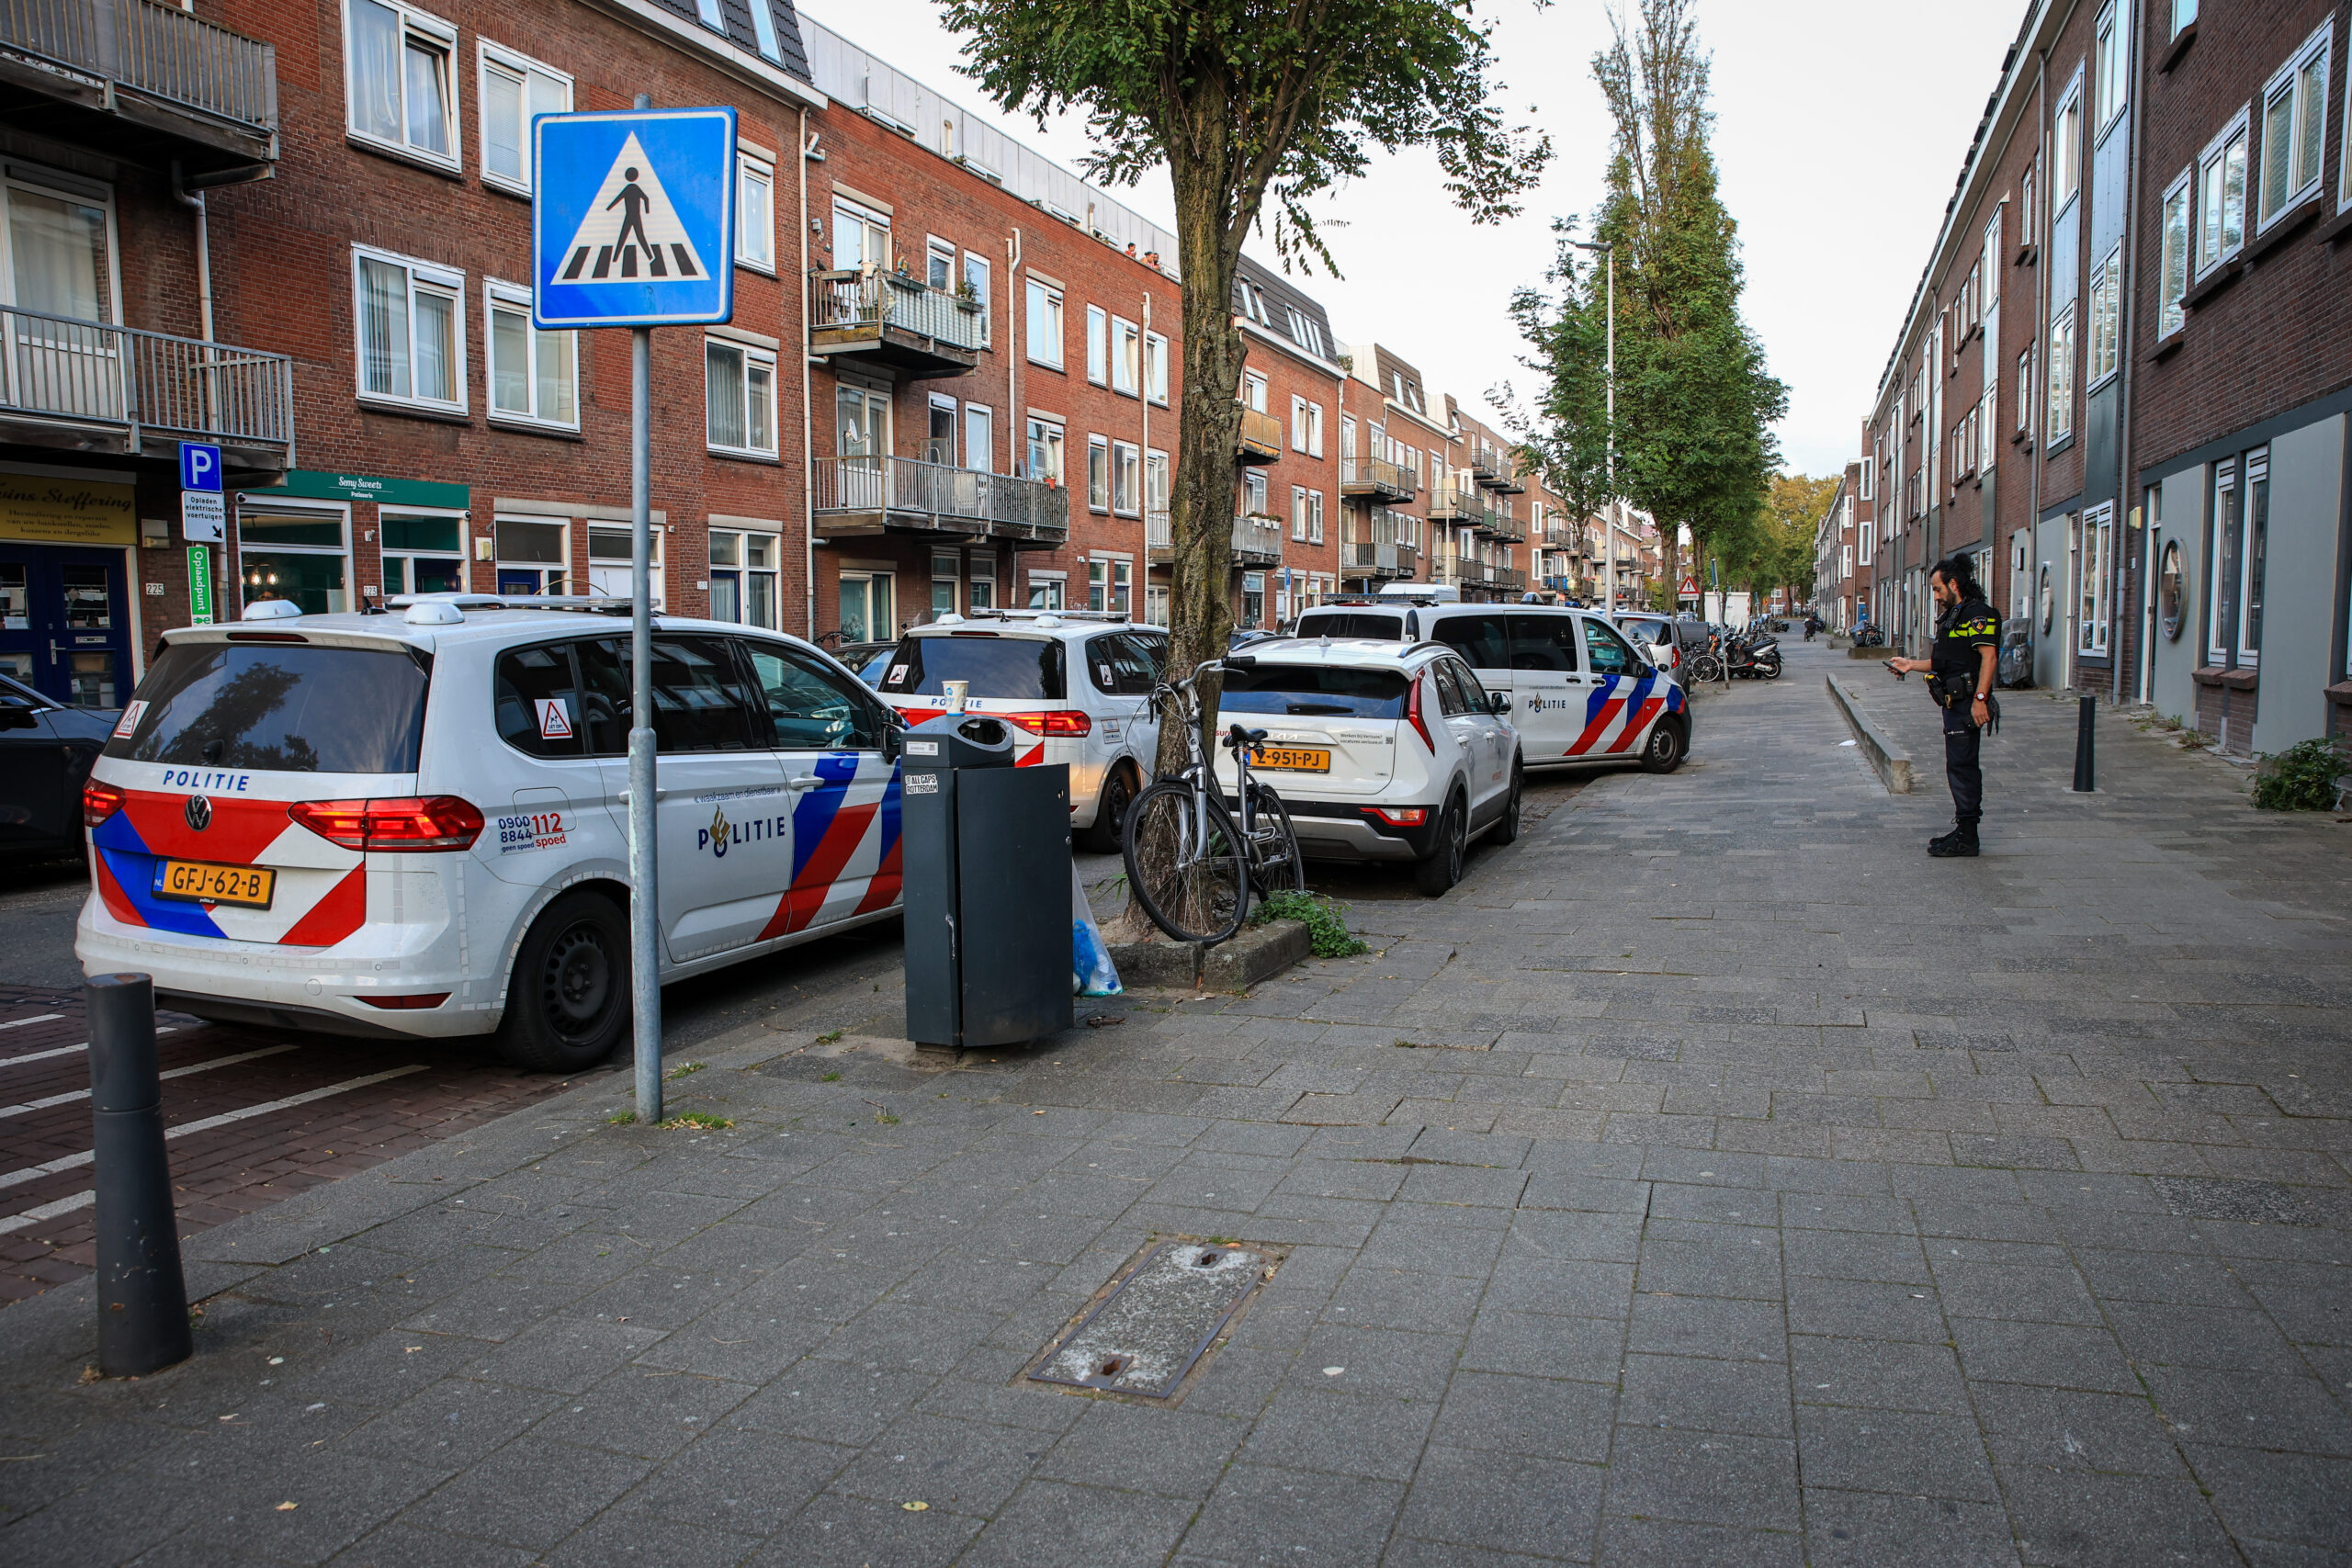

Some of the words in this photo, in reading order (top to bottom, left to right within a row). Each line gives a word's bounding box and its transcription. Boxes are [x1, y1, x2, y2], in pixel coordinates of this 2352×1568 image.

[191, 449, 212, 485] P
[357, 478, 382, 490] Sweets
[41, 489, 131, 512] Stoffering
[190, 497, 218, 505] Opladen
[186, 504, 223, 513] elektrische
[187, 513, 223, 521] voertuigen
[192, 551, 208, 611] Oplaadpunt
[147, 584, 164, 594] 225
[931, 698, 982, 708] POIE
[1528, 700, 1566, 713] POLITIE
[163, 770, 250, 791] POLITIE
[700, 792, 735, 803] waakzaam
[744, 786, 775, 797] dienstbaar
[907, 784, 938, 794] ROTTERDAM
[498, 816, 530, 829] 0900
[531, 812, 563, 834] 112
[501, 828, 533, 843] 8844
[536, 833, 567, 850] spoed
[698, 817, 786, 858] POLITIE
[502, 844, 516, 853] geen
[517, 841, 535, 851] spoed
[154, 878, 164, 886] NL
[173, 866, 261, 897] GFJ-62-B
